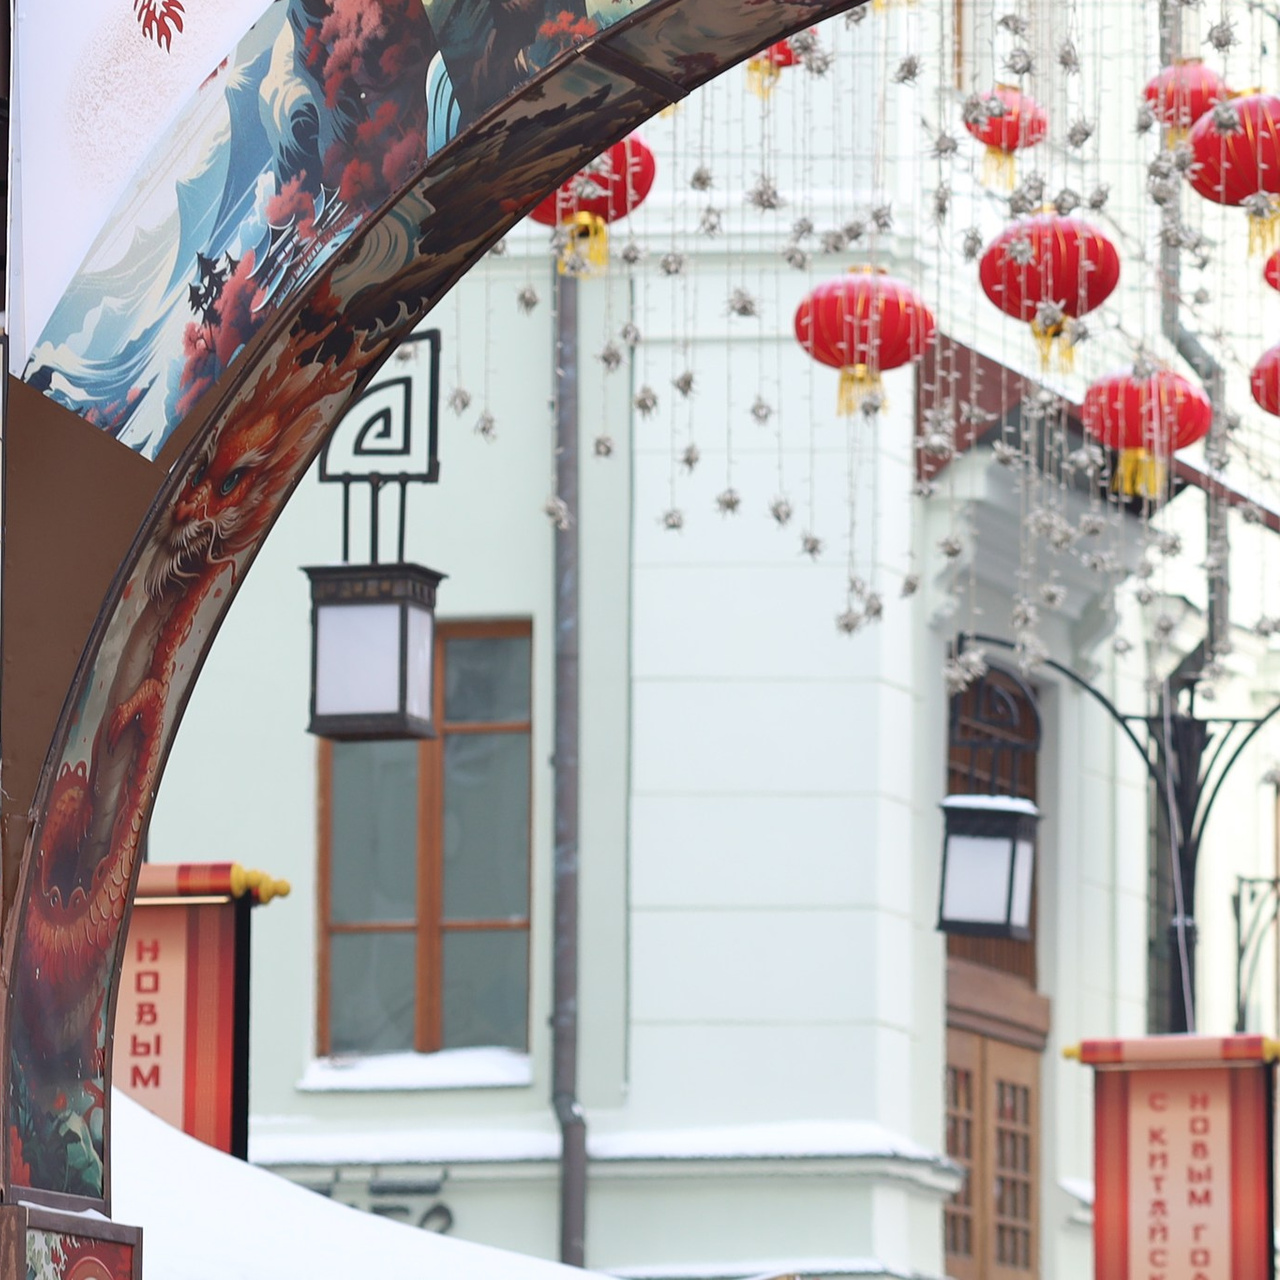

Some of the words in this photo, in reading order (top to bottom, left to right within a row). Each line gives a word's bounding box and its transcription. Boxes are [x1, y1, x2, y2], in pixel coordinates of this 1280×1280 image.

[131, 938, 161, 1089] НОВЫМ
[1148, 1093, 1169, 1112] С
[1187, 1093, 1213, 1207] НОВЫМ
